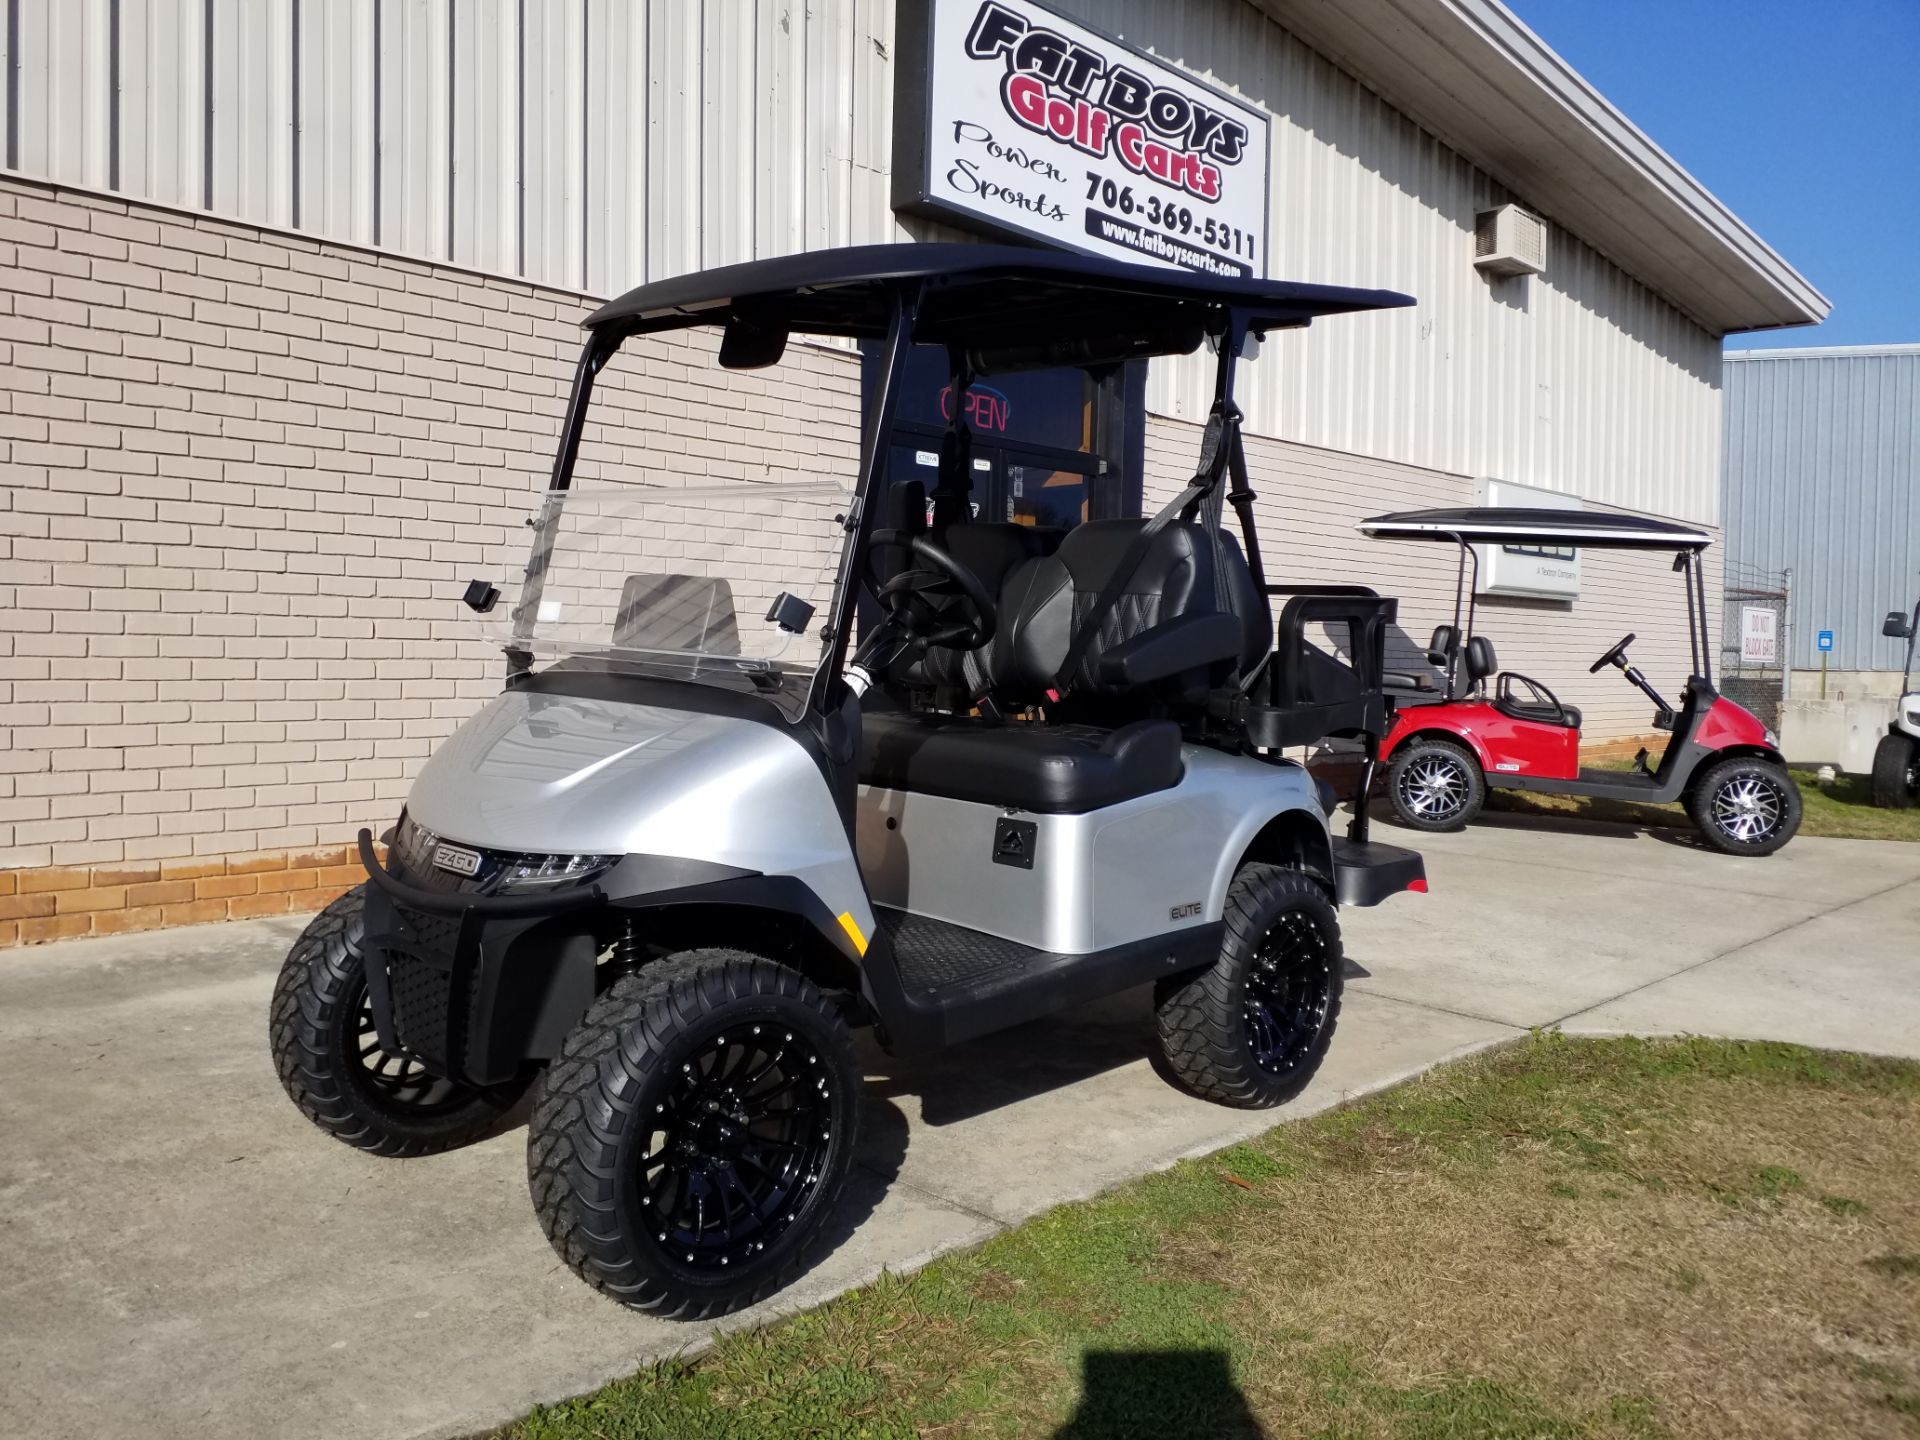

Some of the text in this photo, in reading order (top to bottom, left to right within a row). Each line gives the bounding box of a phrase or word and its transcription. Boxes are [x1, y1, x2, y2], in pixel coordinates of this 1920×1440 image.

[1001, 71, 1222, 204] Golf Carts
[1104, 64, 1248, 165] BOYS
[952, 119, 1067, 183] Power
[947, 158, 1069, 222] Sports
[1085, 171, 1255, 260] 706-369-5311
[1102, 219, 1241, 278] www.fatboyscarts.com
[1745, 636, 1774, 657] BLOCK GATE
[1752, 614, 1770, 634] DO NOT
[434, 848, 476, 872] EZGO
[1171, 902, 1201, 919] ELITE
